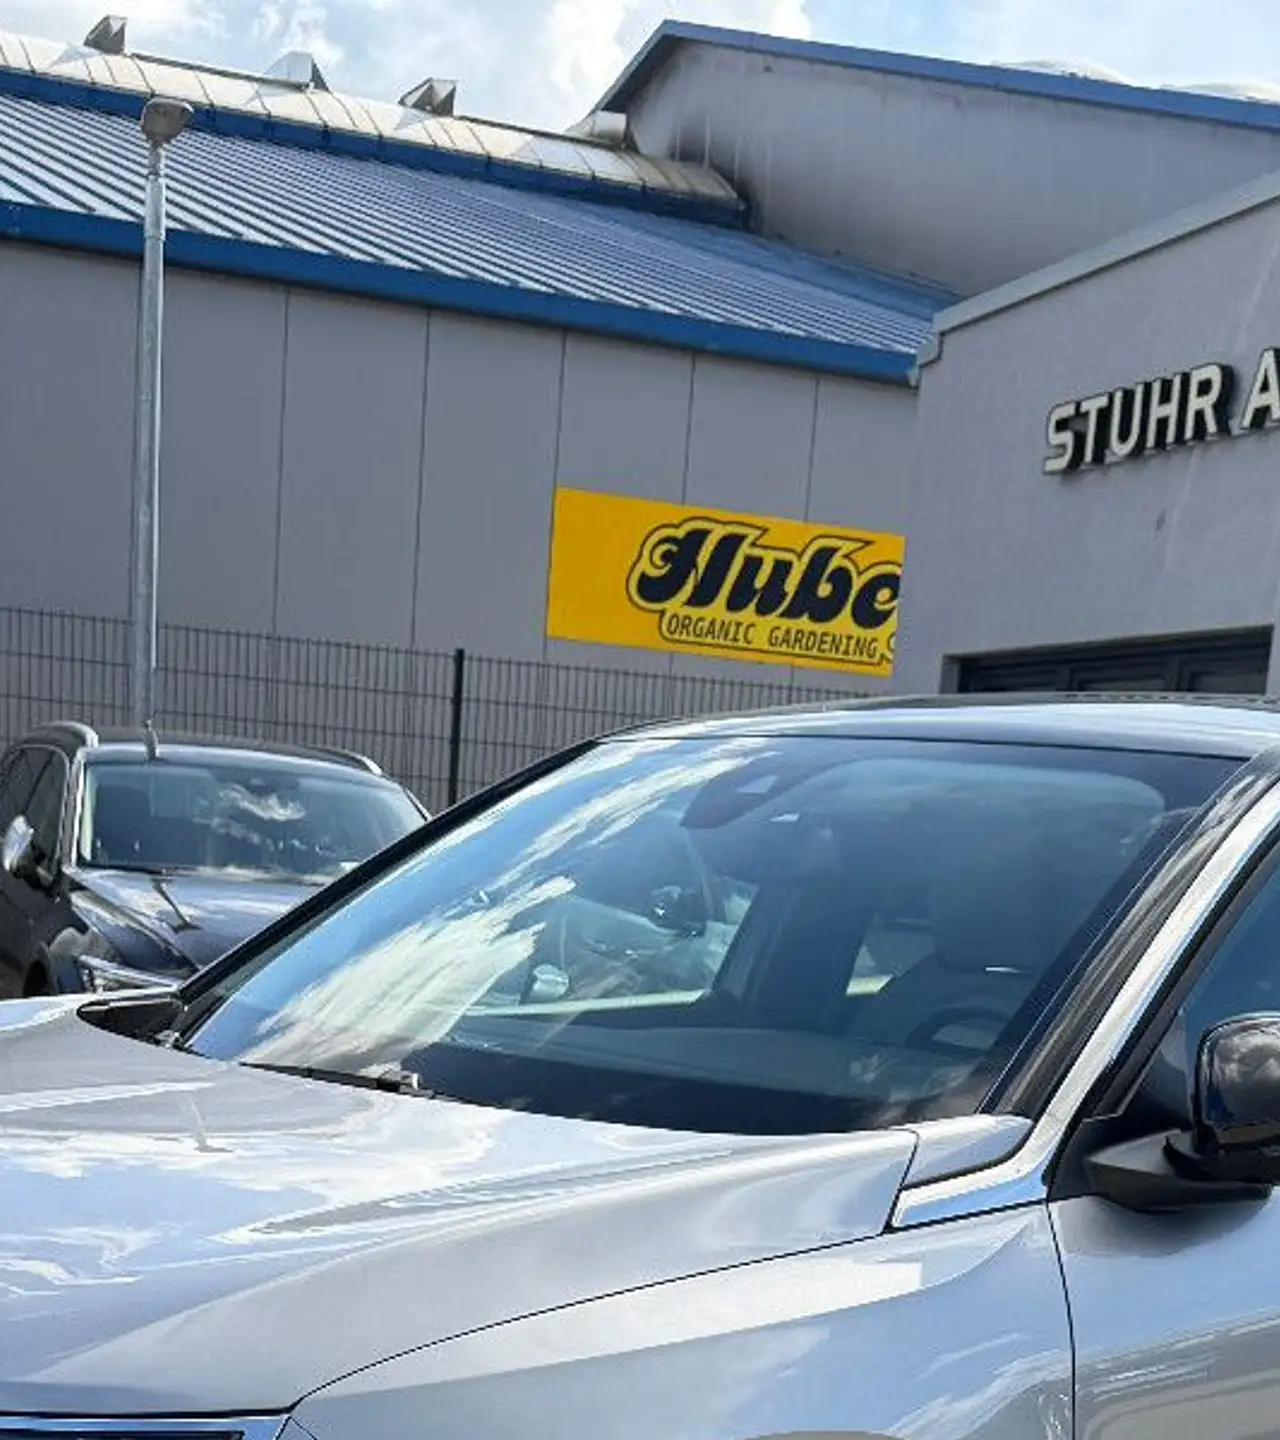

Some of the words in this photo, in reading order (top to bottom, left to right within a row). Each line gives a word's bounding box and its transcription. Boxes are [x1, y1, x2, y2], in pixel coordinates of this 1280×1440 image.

[1042, 362, 1232, 476] STUHR
[665, 612, 757, 646] ORGANIC
[768, 625, 879, 659] GARDENING
